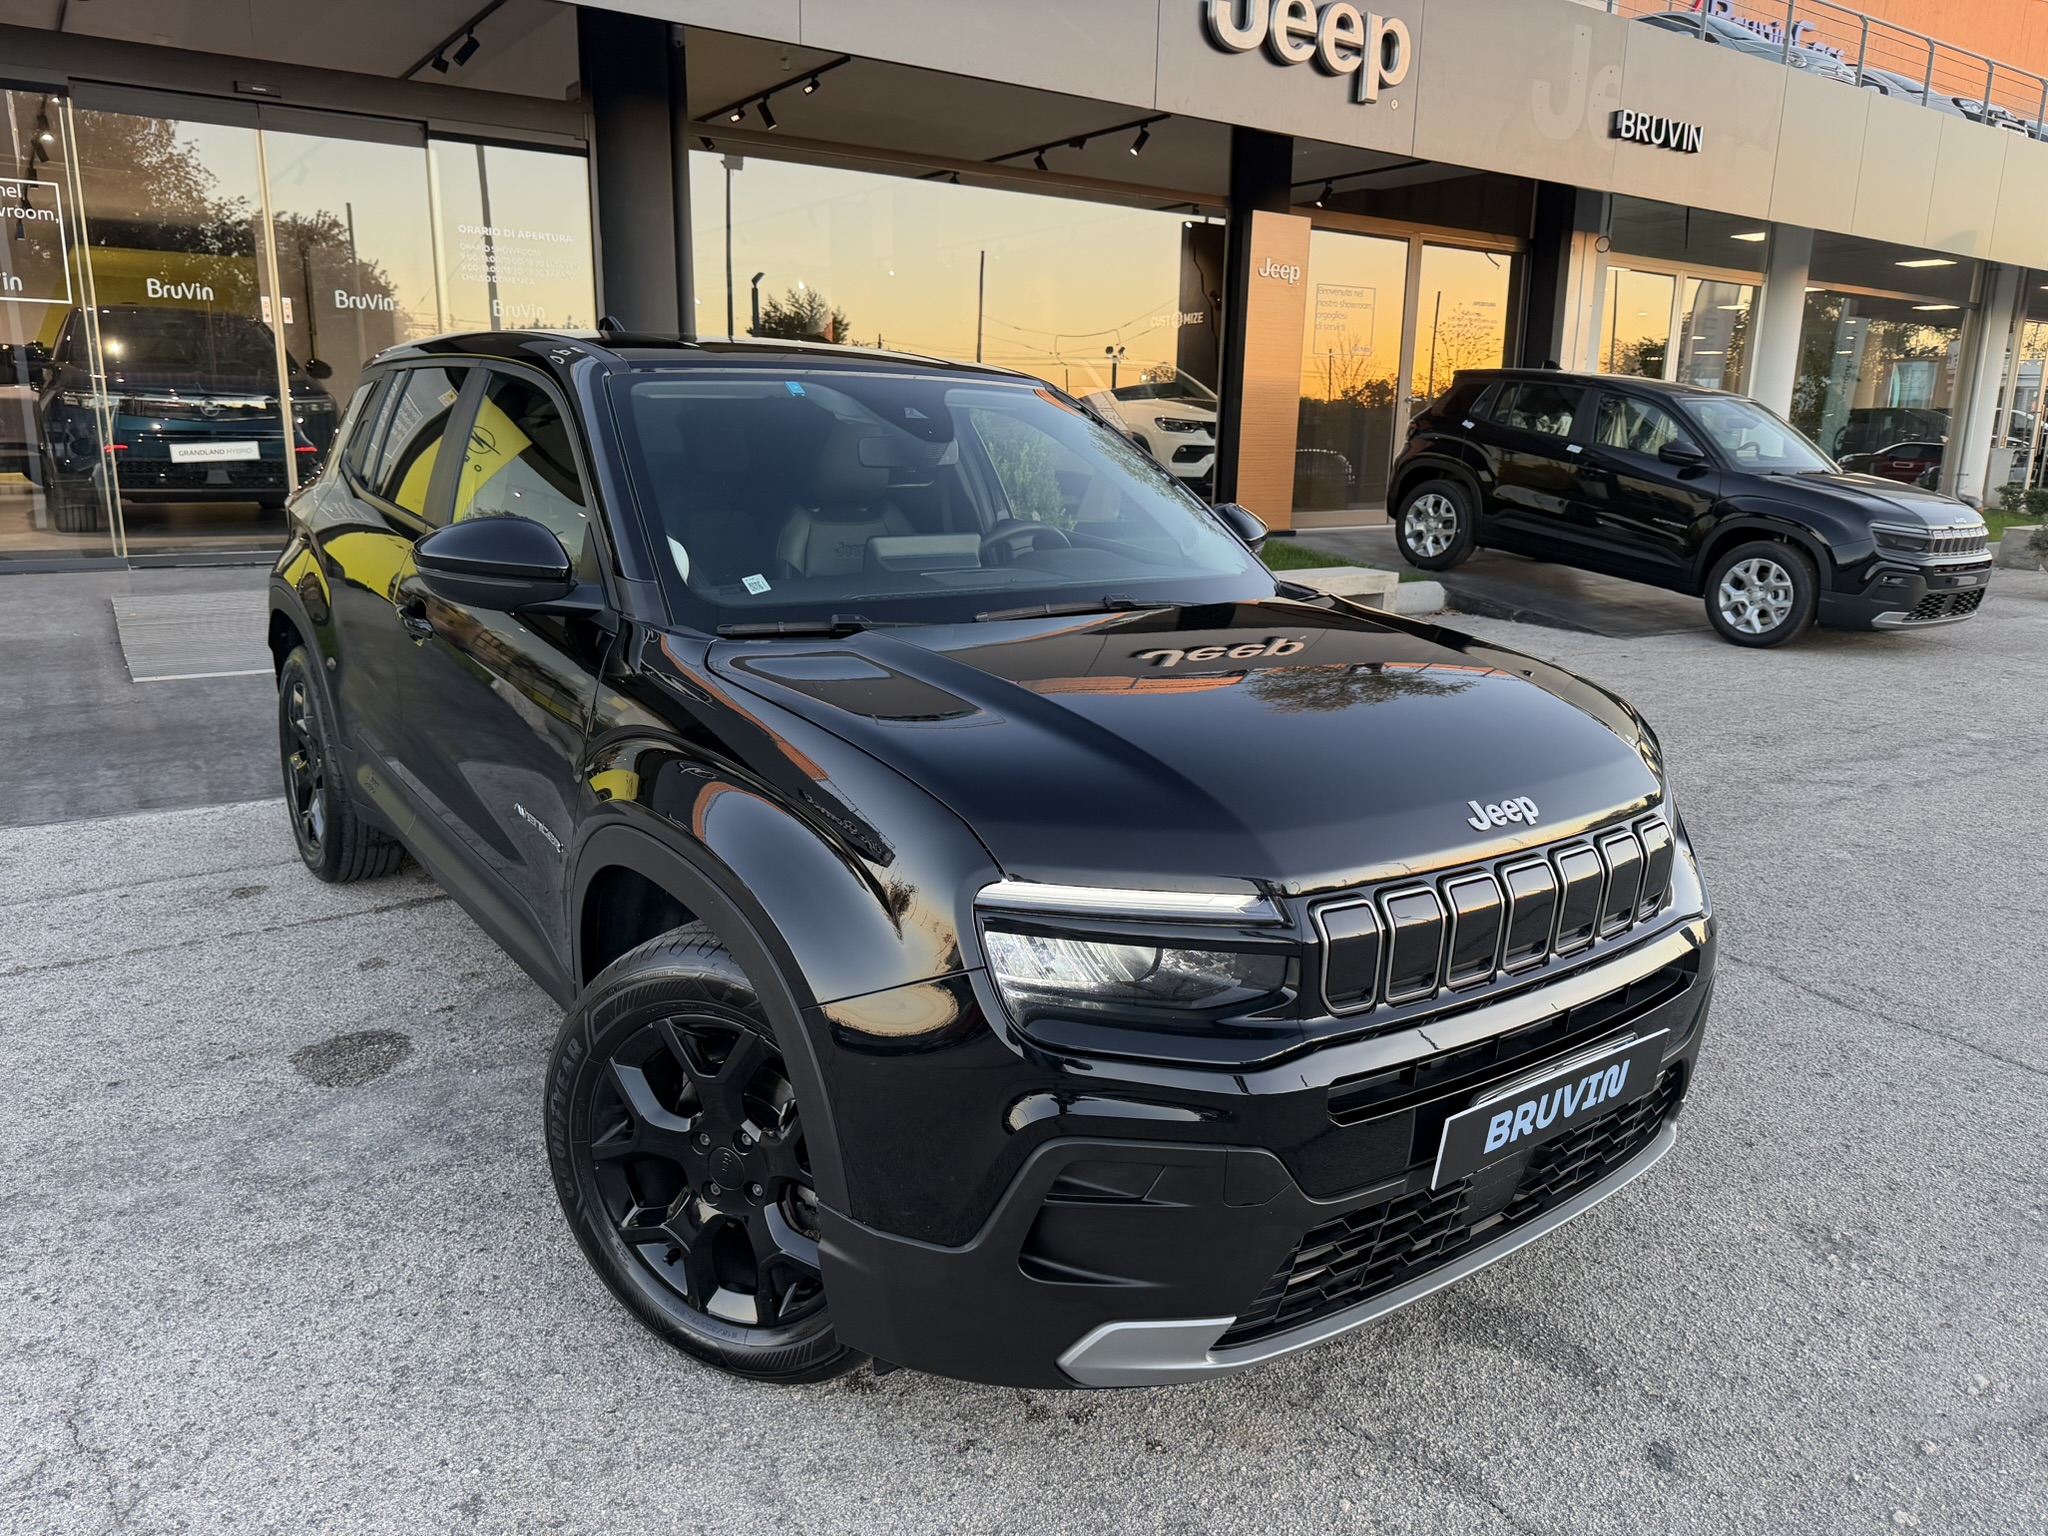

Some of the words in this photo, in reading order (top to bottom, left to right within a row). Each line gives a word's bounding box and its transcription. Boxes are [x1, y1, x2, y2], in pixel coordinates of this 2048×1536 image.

[1198, 0, 1411, 103] Jeep
[1617, 108, 1704, 153] BRUVIN
[458, 224, 501, 236] ORARIO
[503, 228, 515, 239] DI
[518, 230, 573, 244] APERTURA
[1258, 257, 1300, 285] Jeep
[146, 278, 214, 301] BruVin
[334, 289, 394, 311] BruVin
[492, 299, 546, 319] BruVin
[178, 448, 225, 457] GRANDLAND
[226, 447, 253, 456] HYBRID
[1466, 796, 1540, 831] Jeep
[550, 1037, 584, 1199] GOODYEAR
[1483, 1058, 1631, 1155] BRUVIN
